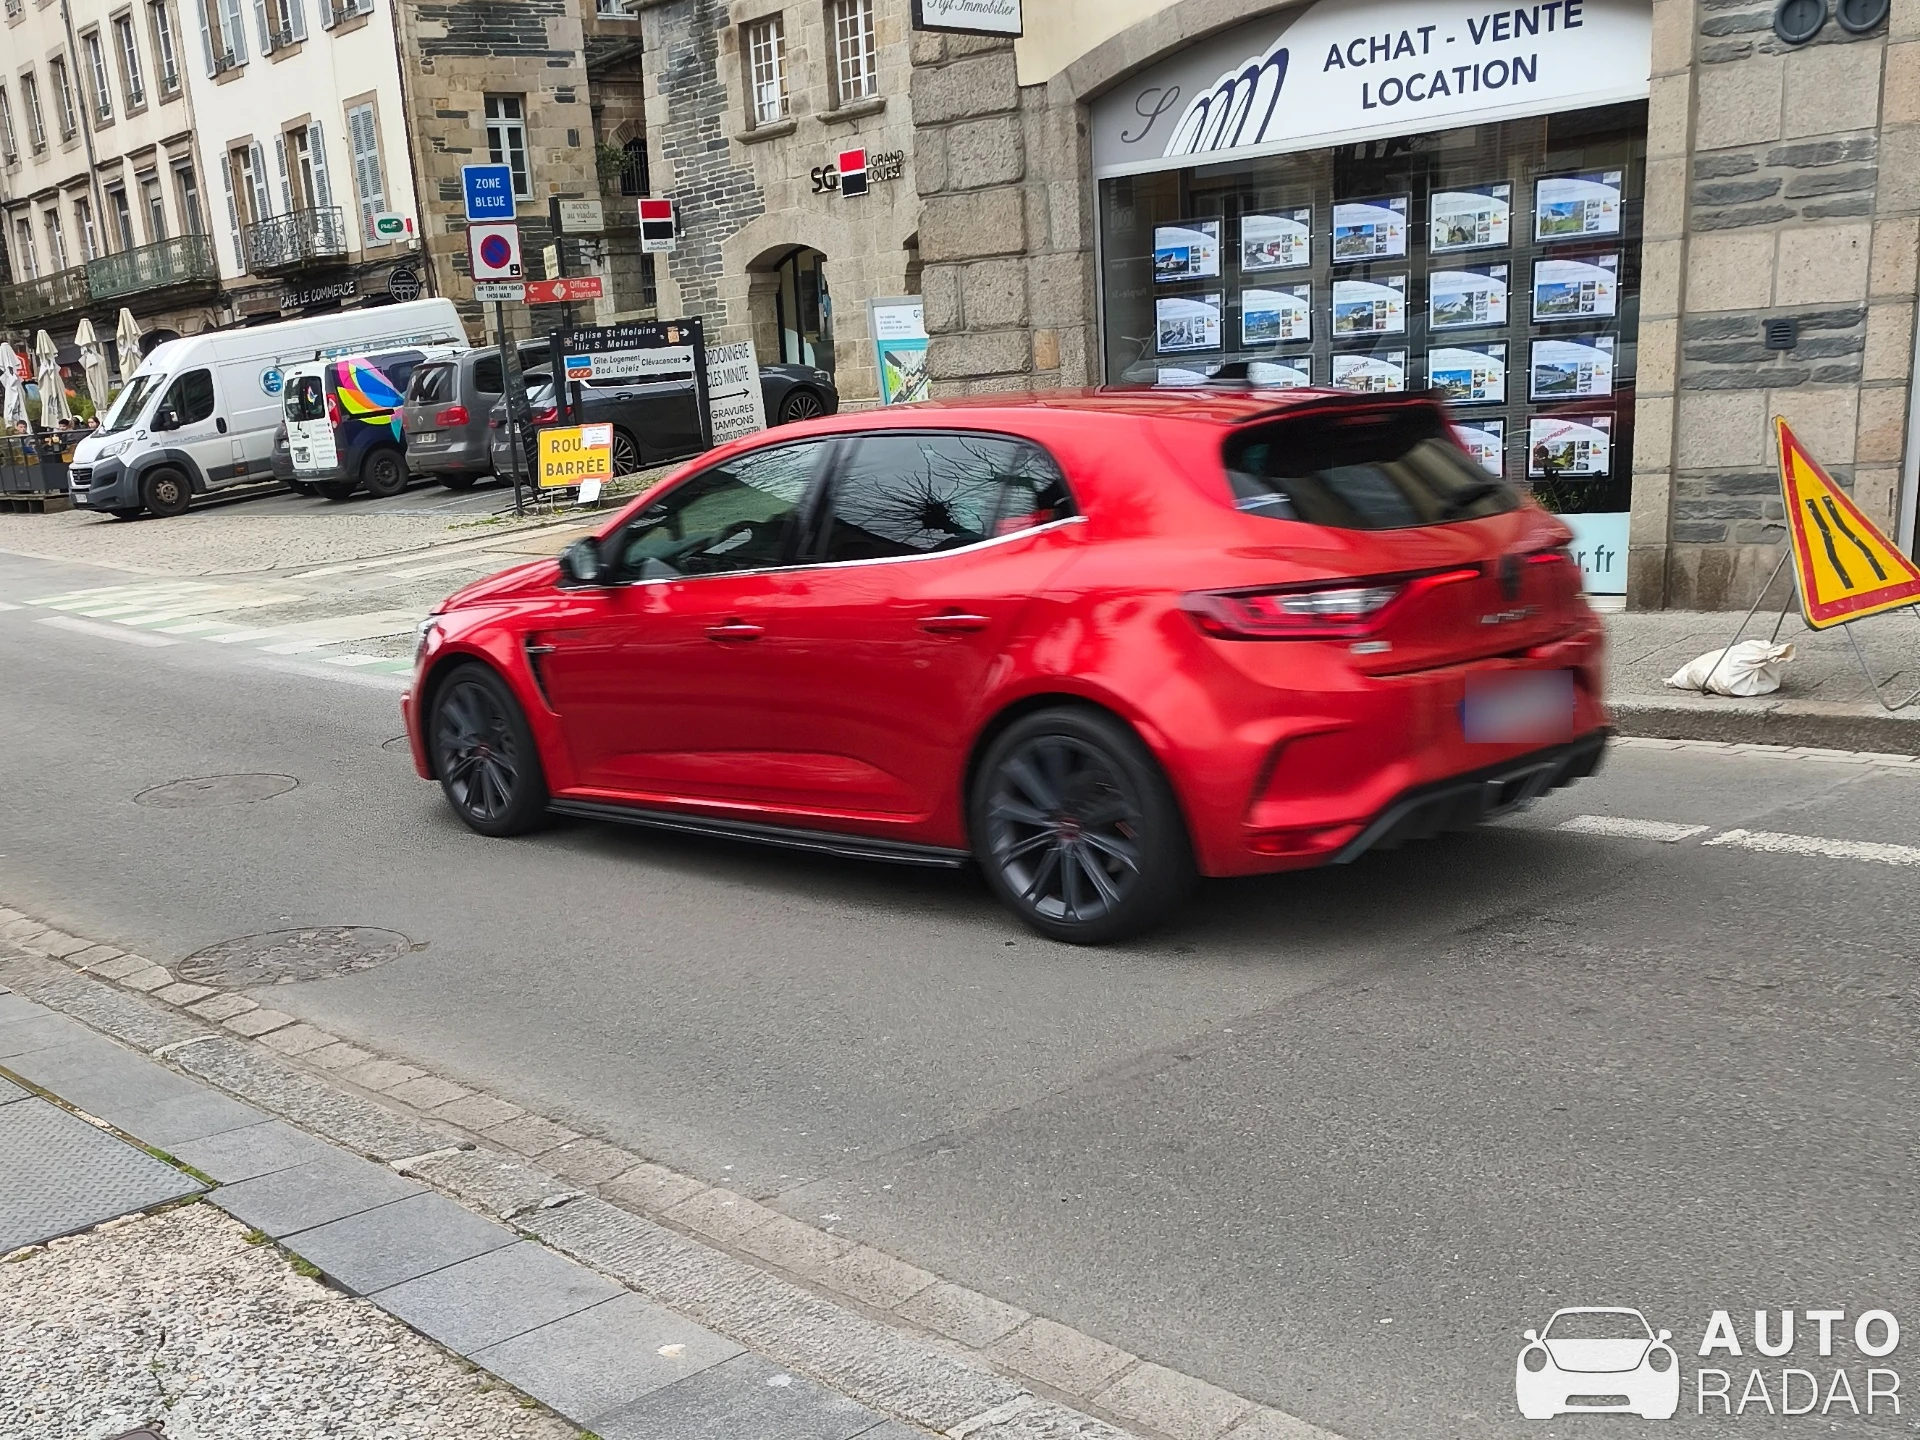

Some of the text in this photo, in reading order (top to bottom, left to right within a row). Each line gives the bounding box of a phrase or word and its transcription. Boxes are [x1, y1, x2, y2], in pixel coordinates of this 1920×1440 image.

[1323, 25, 1437, 72] ACHAT
[1466, 1, 1584, 46] VENTE
[1361, 54, 1538, 110] LOCATION
[871, 149, 904, 167] GRAND
[811, 164, 837, 193] SG
[872, 163, 902, 182] OUEST
[475, 178, 501, 189] ZONE
[475, 196, 506, 207] BLEUE
[576, 209, 598, 219] viaduc
[300, 291, 309, 304] LE
[311, 281, 355, 302] COMMERCE
[569, 281, 589, 289] Office
[570, 289, 601, 299] Tourisme
[606, 326, 657, 338] St-Melaine
[607, 338, 638, 348] Melani
[609, 354, 640, 365] Logement
[704, 342, 749, 366] ORDONNERIE
[723, 365, 749, 385] MINUTE
[711, 403, 755, 419] GRAVURES
[714, 415, 755, 430] TAMPONS
[136, 430, 148, 441] 2
[712, 430, 733, 443] RODUITS
[551, 437, 588, 454] ROU
[546, 456, 605, 477] BARRÉE
[1573, 544, 1615, 572] r.fr
